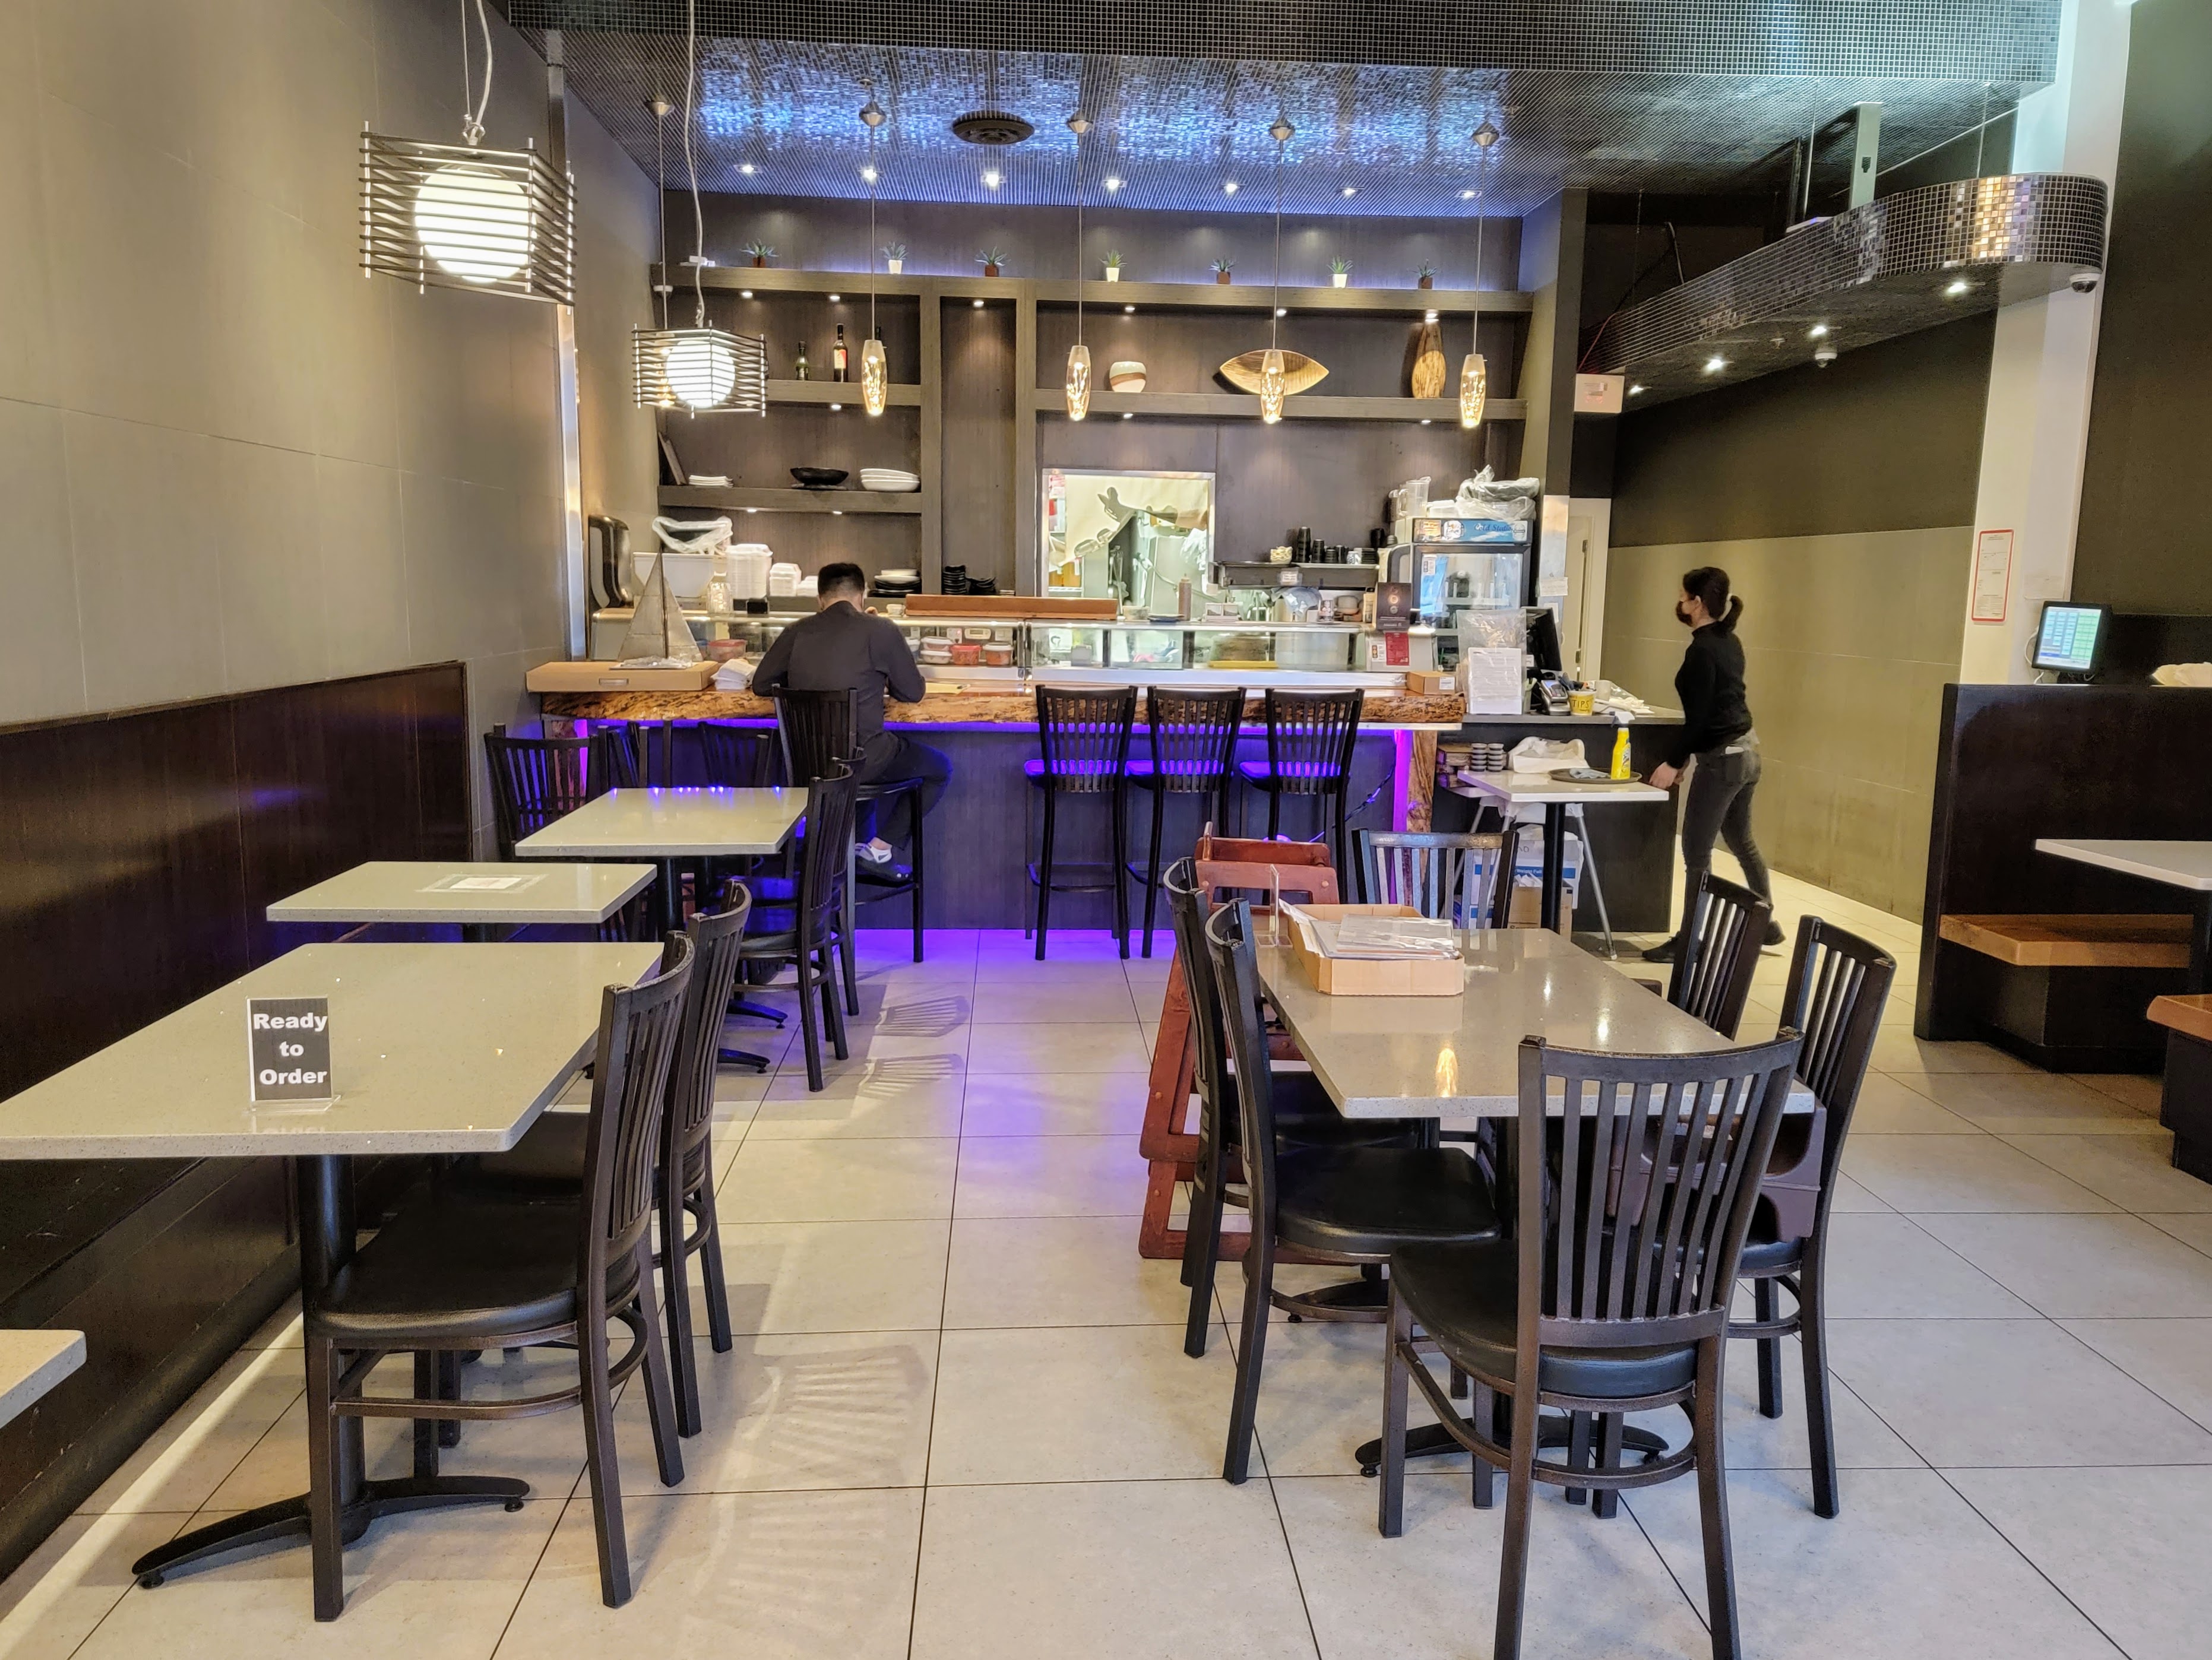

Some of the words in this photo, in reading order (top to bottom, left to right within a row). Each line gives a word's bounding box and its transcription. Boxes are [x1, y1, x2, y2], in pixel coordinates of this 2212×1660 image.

[1572, 699, 1590, 709] TIPS
[254, 1012, 328, 1032] Ready
[279, 1041, 305, 1057] to
[260, 1068, 328, 1085] Order
